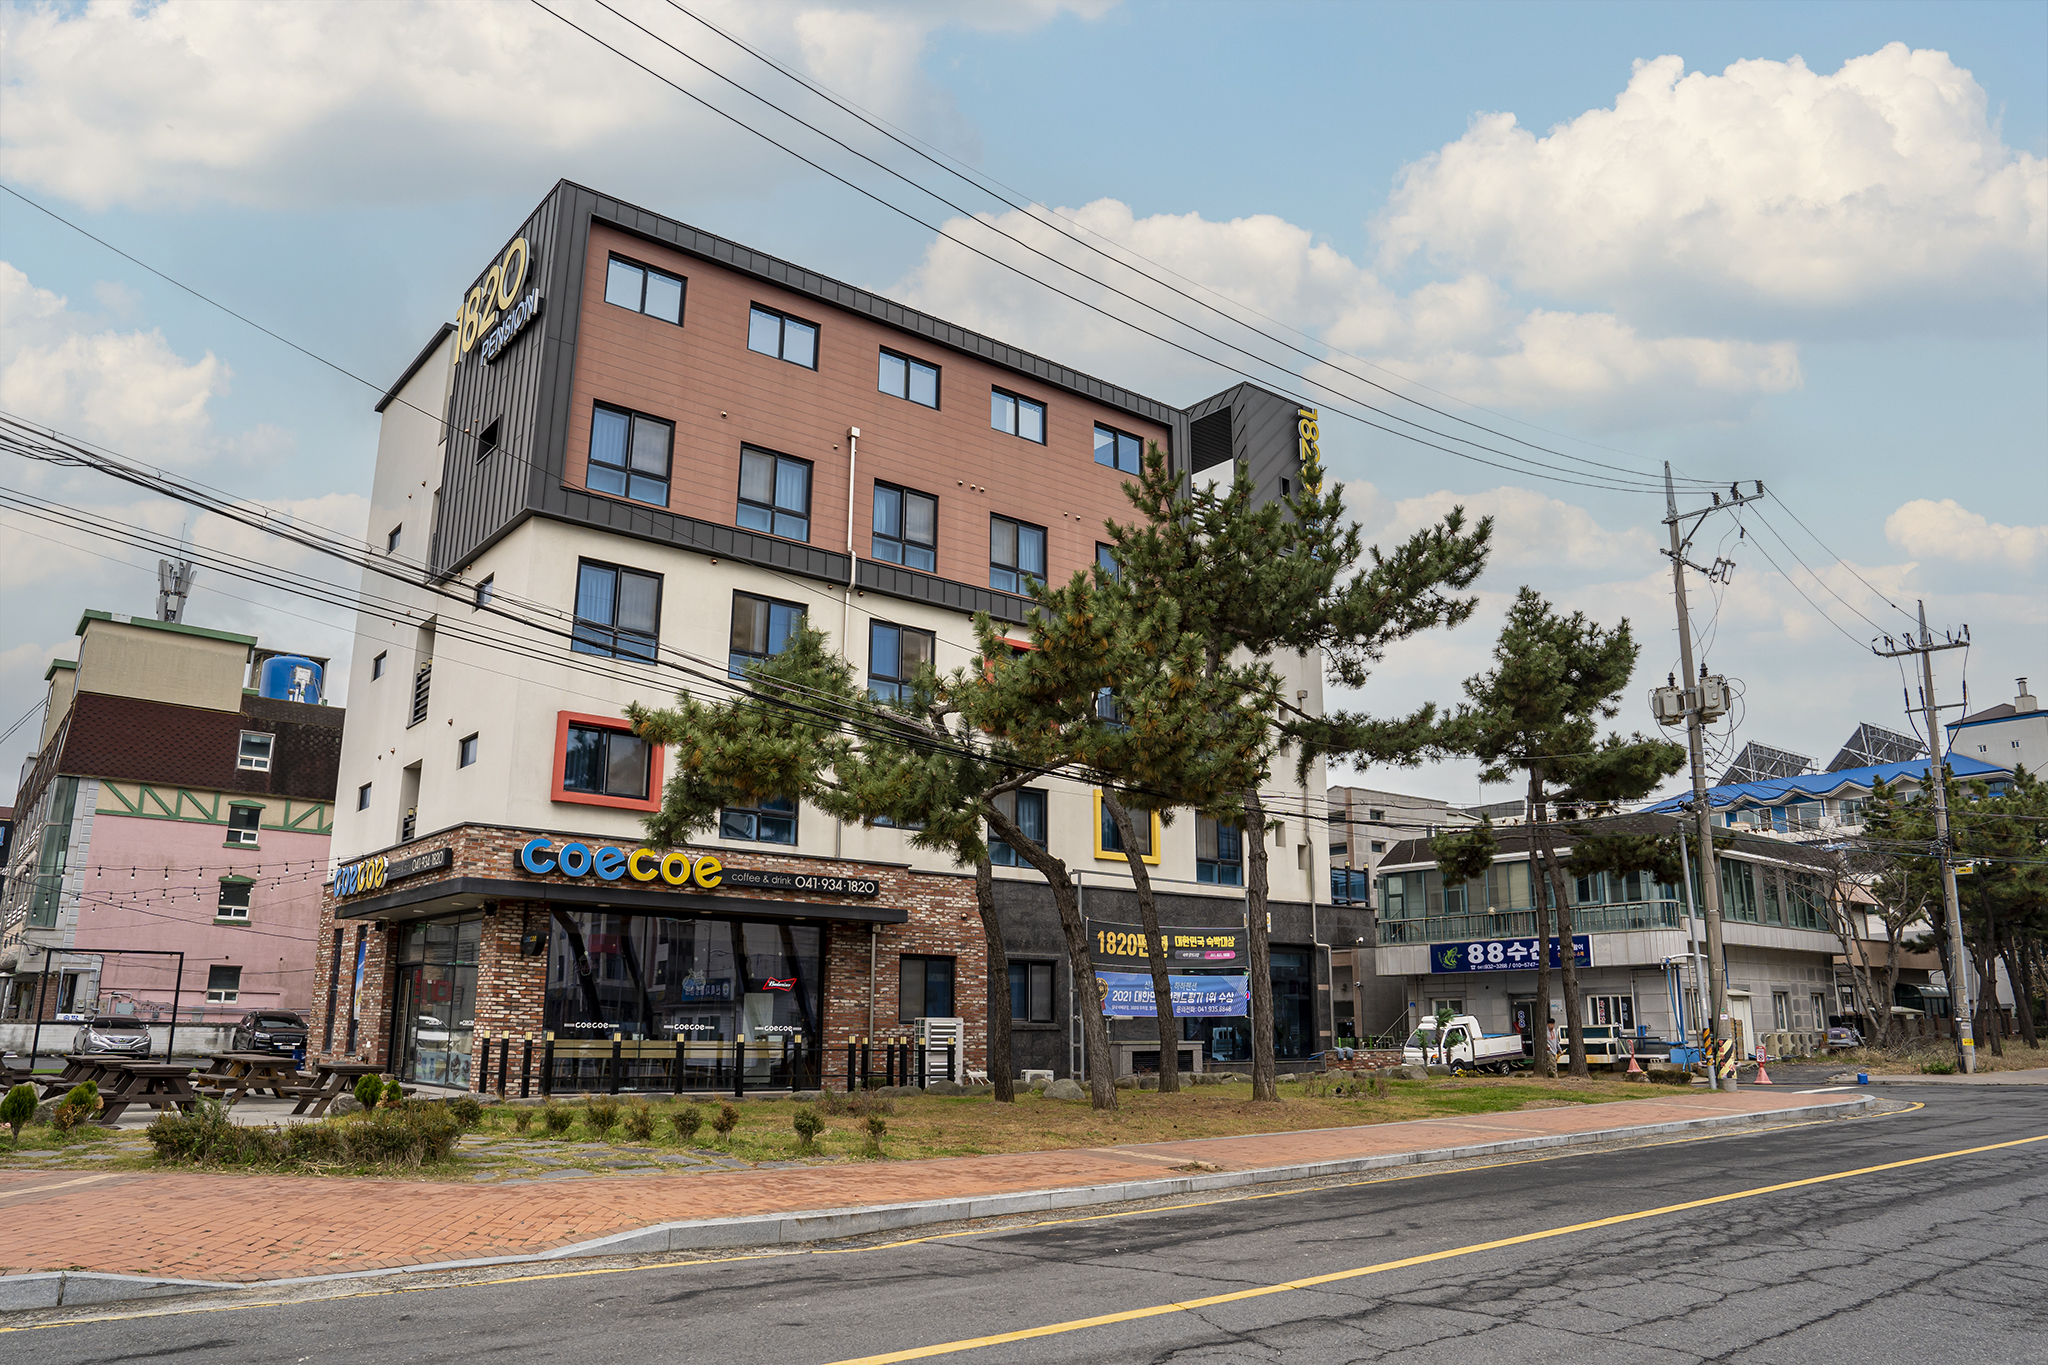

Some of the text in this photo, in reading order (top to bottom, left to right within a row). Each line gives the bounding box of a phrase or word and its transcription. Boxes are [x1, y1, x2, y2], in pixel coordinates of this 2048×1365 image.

[454, 237, 530, 366] 1820
[481, 288, 539, 367] PENSION
[521, 838, 723, 888] coecoe
[334, 856, 387, 897] coecoe
[732, 873, 760, 883] coffee
[763, 875, 769, 883] &
[772, 875, 792, 885] drink
[1174, 935, 1236, 948] 대한민국 숙박대상
[1112, 990, 1132, 1002] 2021
[1134, 990, 1156, 1003] 대한민
[1219, 991, 1235, 1004] 수상
[575, 1021, 609, 1029] coecoe
[674, 1023, 705, 1031] coecoe
